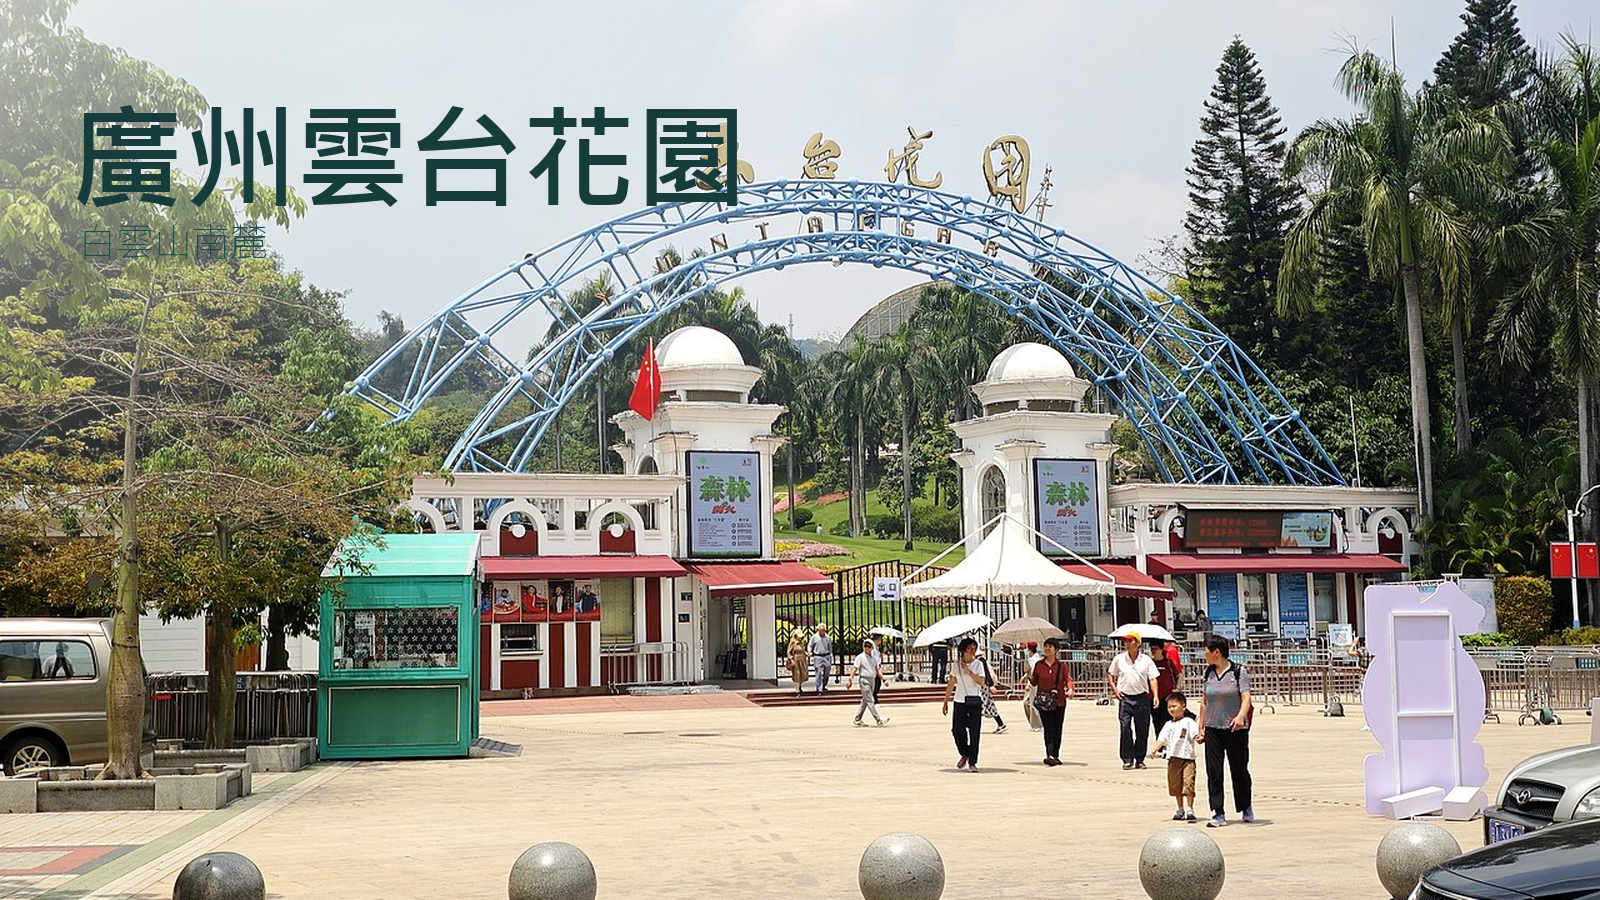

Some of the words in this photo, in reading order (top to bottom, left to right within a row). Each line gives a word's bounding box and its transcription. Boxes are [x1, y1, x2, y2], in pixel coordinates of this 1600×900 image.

[699, 475, 751, 502] 森林
[1045, 481, 1090, 507] 森林
[877, 582, 897, 592] 出口
